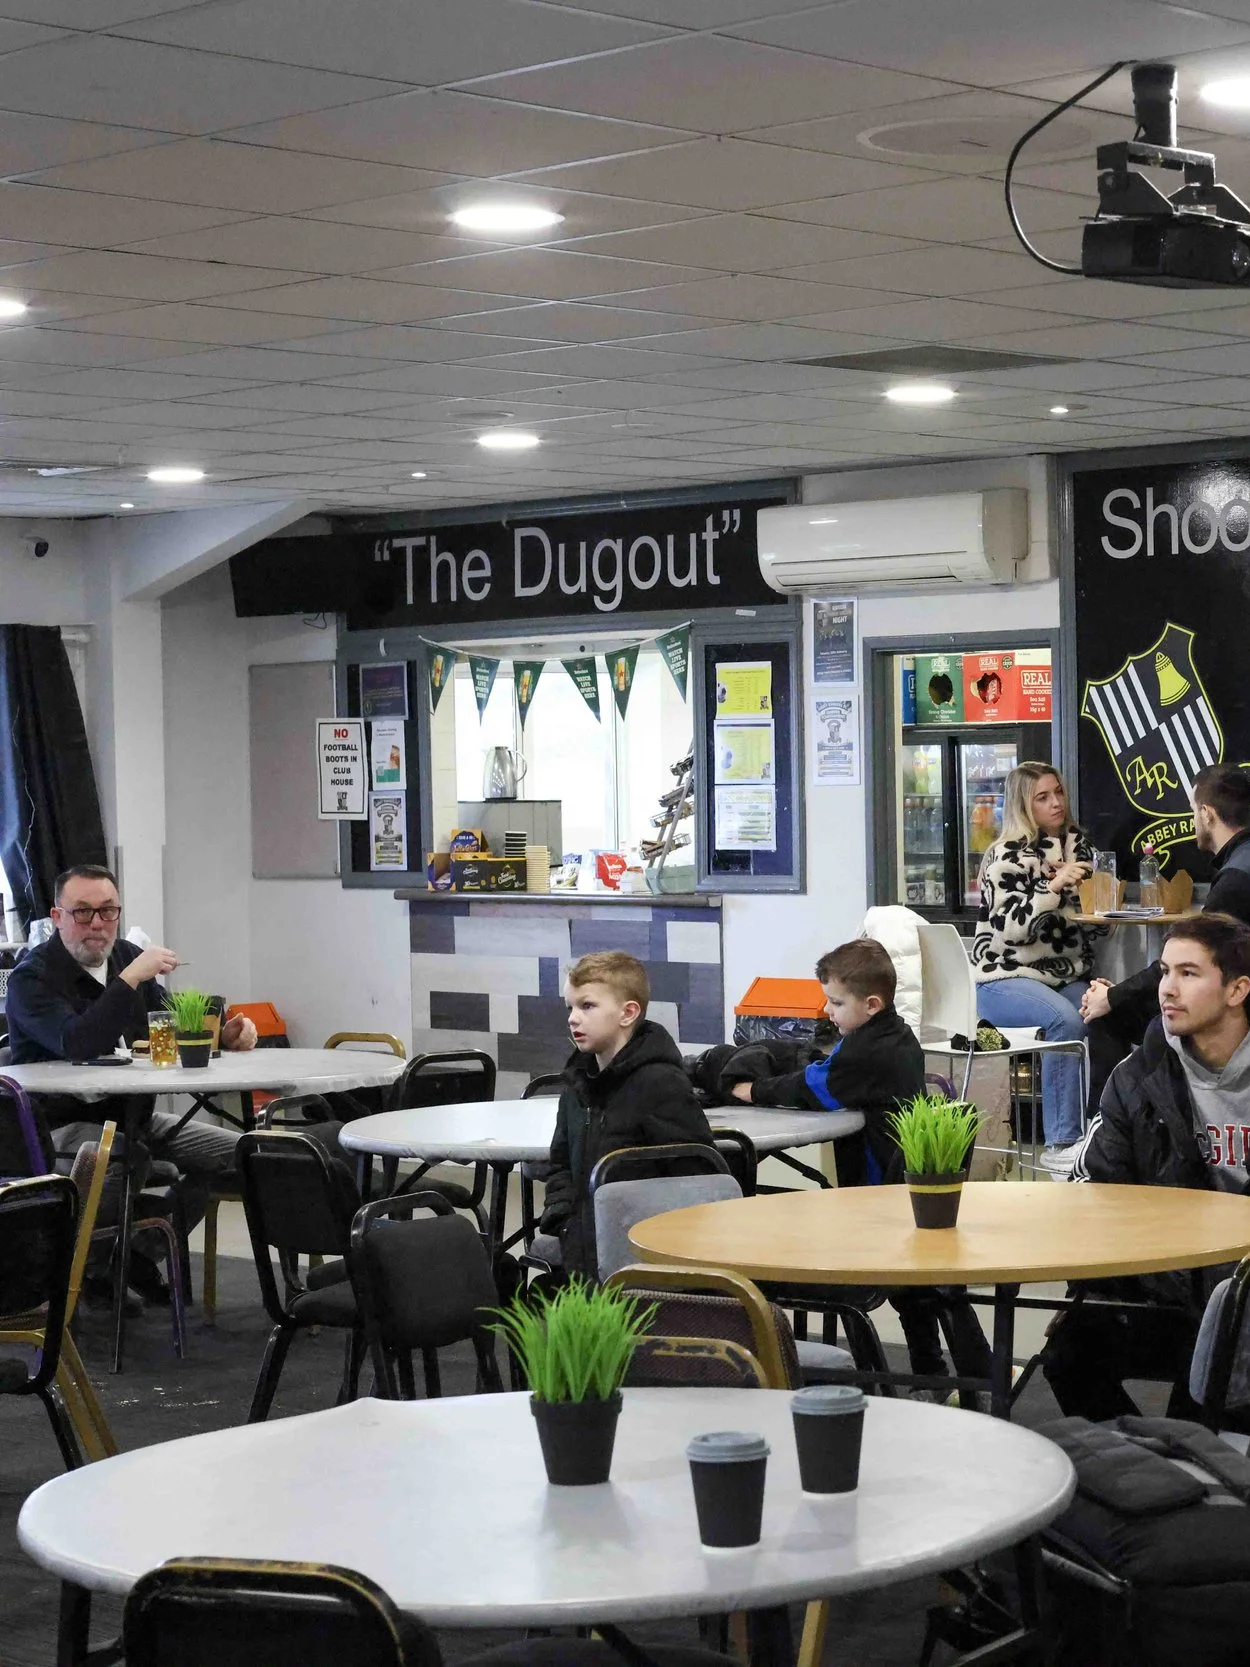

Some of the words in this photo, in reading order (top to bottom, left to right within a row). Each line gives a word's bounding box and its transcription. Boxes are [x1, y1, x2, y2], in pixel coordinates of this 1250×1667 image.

[832, 615, 848, 624] NIGHT
[1023, 672, 1052, 686] REAL
[334, 728, 349, 739] NO
